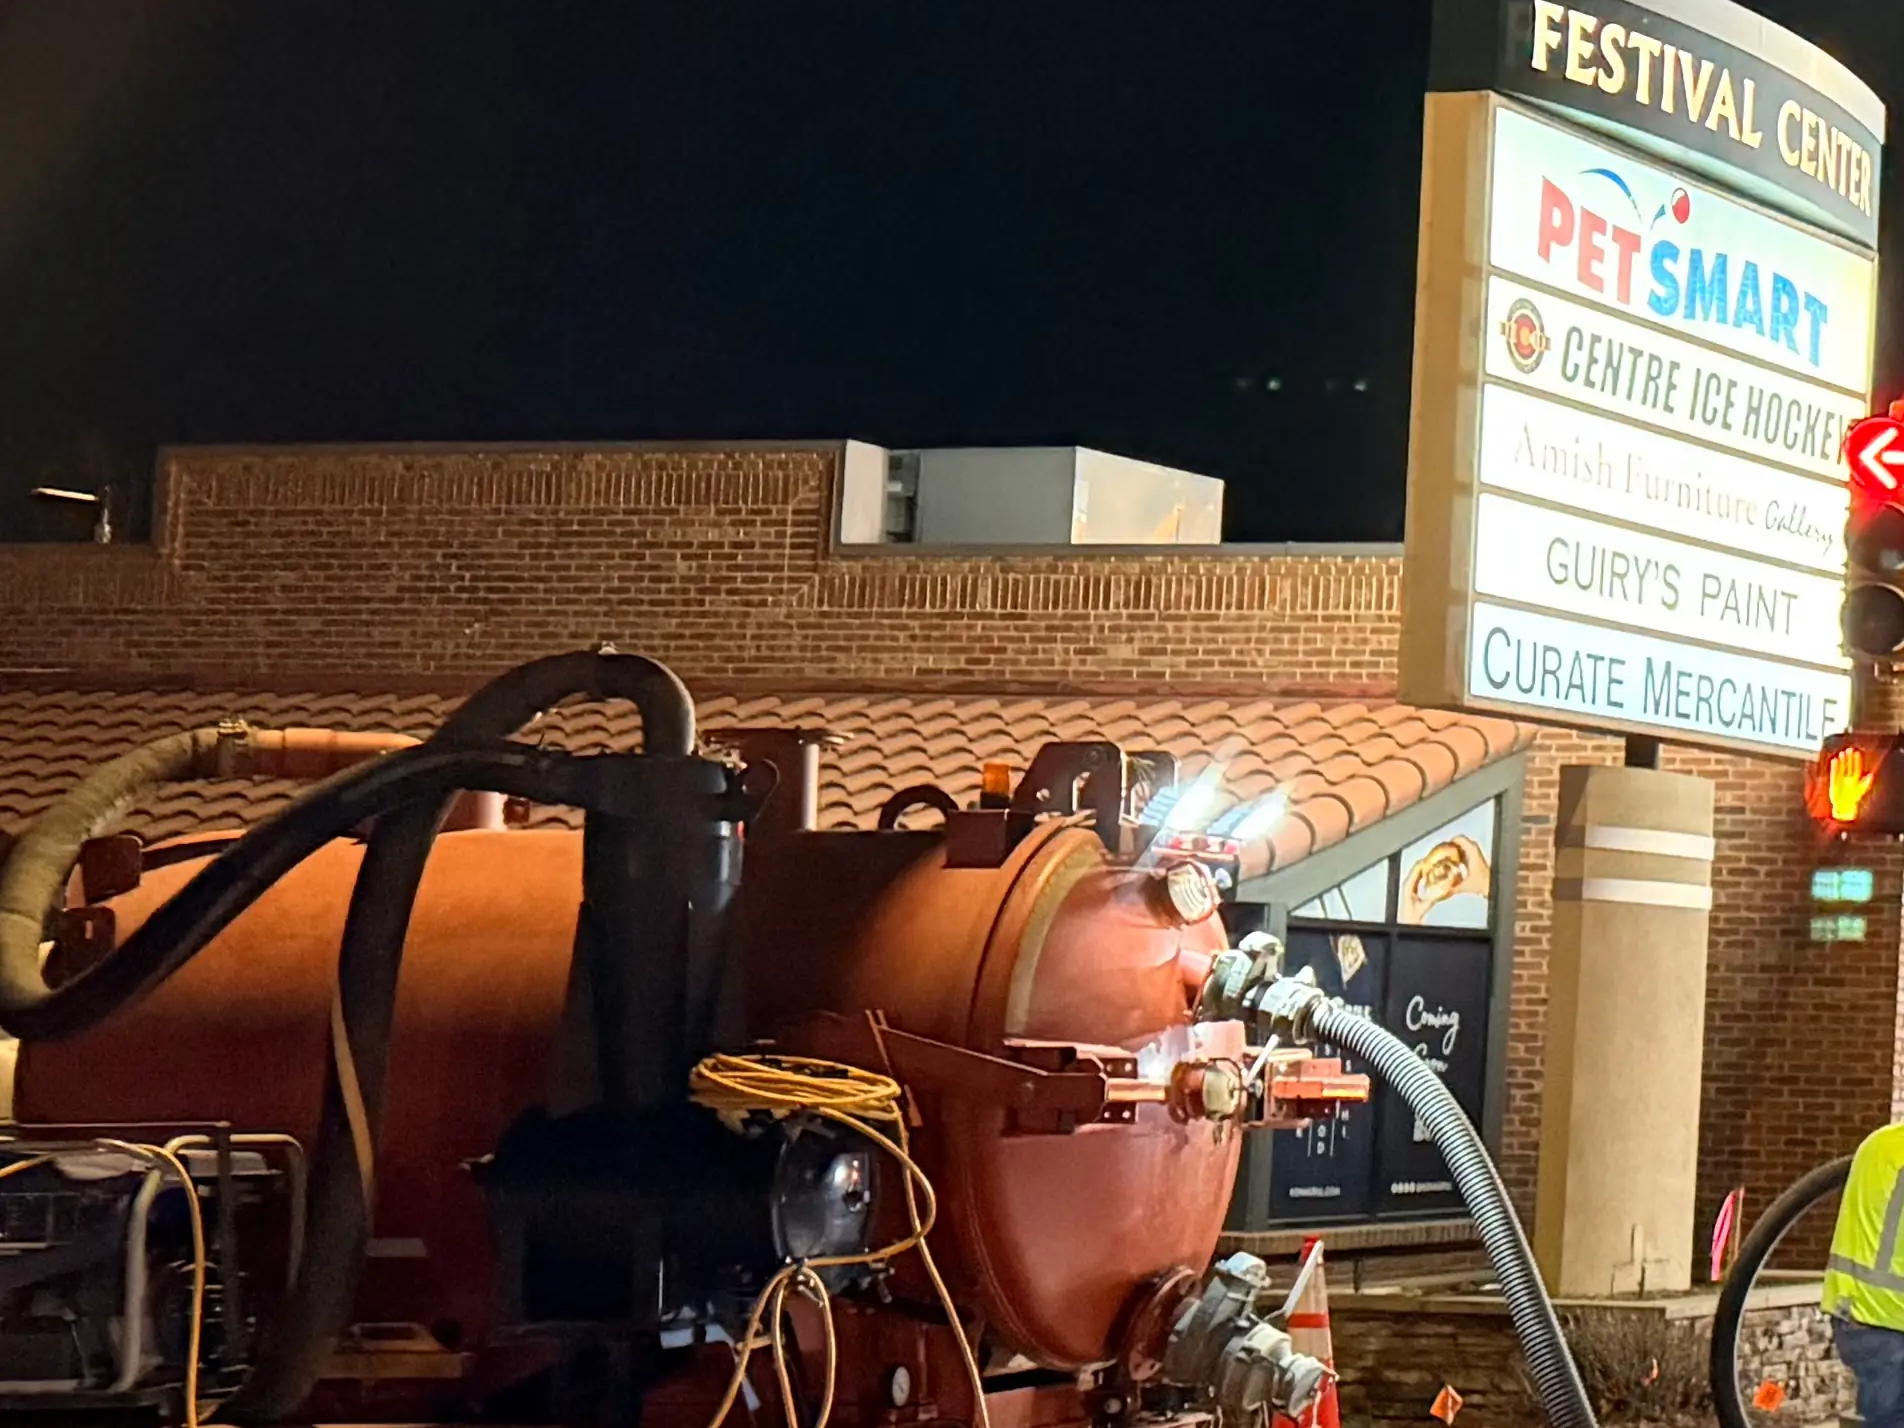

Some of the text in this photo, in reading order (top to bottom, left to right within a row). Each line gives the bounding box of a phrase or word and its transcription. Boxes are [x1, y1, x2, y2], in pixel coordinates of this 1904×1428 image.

[1777, 99, 1873, 217] CENTER
[1537, 175, 1829, 369] PETSMART
[1561, 324, 1678, 421] CENTRE
[1689, 368, 1738, 431] ICE
[1513, 422, 1836, 554] Amish Furniture Gallery
[1546, 536, 1798, 636] GUIRY'S PAINT
[1483, 625, 1837, 741] CURATE MERCANTILE
[1406, 994, 1460, 1054] Coming
